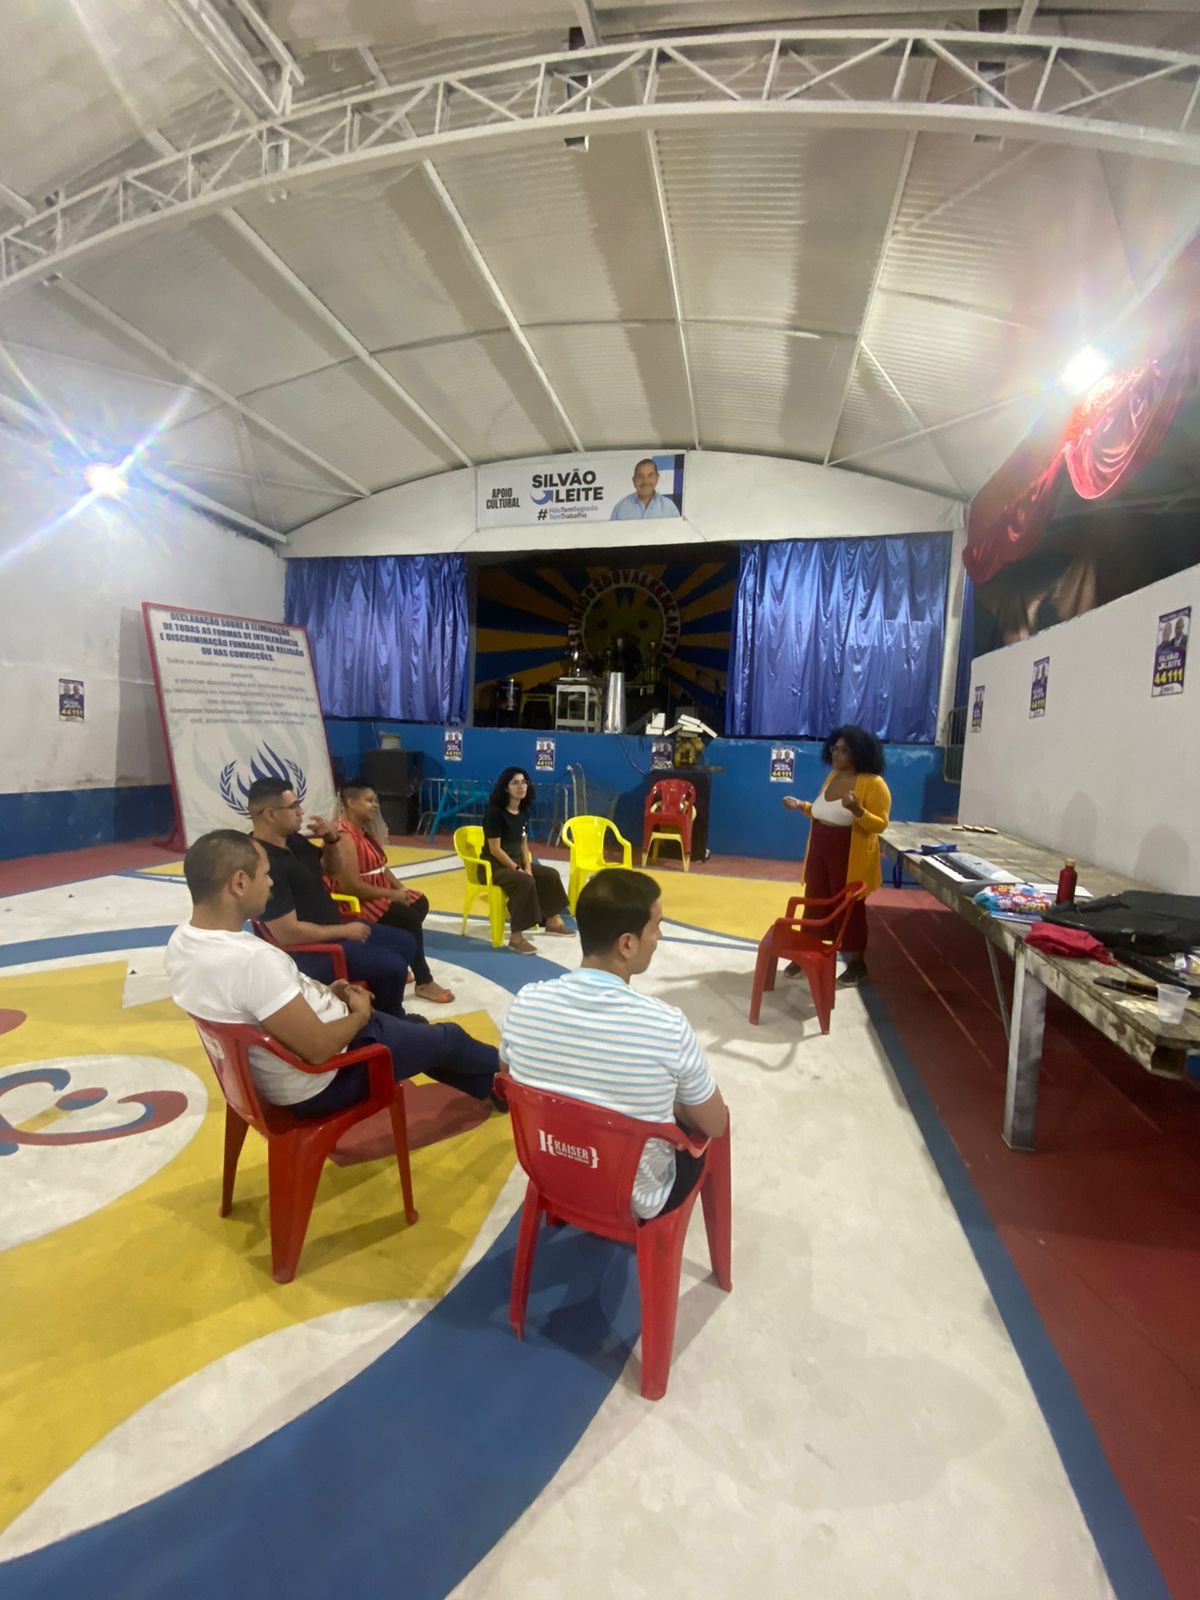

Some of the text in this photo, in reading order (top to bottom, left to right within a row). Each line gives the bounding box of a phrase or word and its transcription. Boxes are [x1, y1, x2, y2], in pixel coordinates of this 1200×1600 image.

[532, 468, 596, 488] SILVÃO
[492, 488, 513, 498] APOIO
[554, 487, 604, 503] LEITE
[486, 498, 520, 509] CULTURAL
[170, 612, 220, 626] DECLARAÇÃO
[220, 619, 244, 629] SOBRE
[251, 623, 290, 637] ELIMINAÇÃO
[163, 622, 299, 647] DE TODAS AS FORMAS DE INTOLERÂNCIA
[160, 632, 304, 657] E DISCRIMINAÇÃO FUNDADAS NA RELIGIÃO
[201, 646, 212, 655] OU
[213, 648, 228, 657] NAS
[1155, 668, 1183, 685] 44111
[554, 1139, 589, 1161] KAISER
